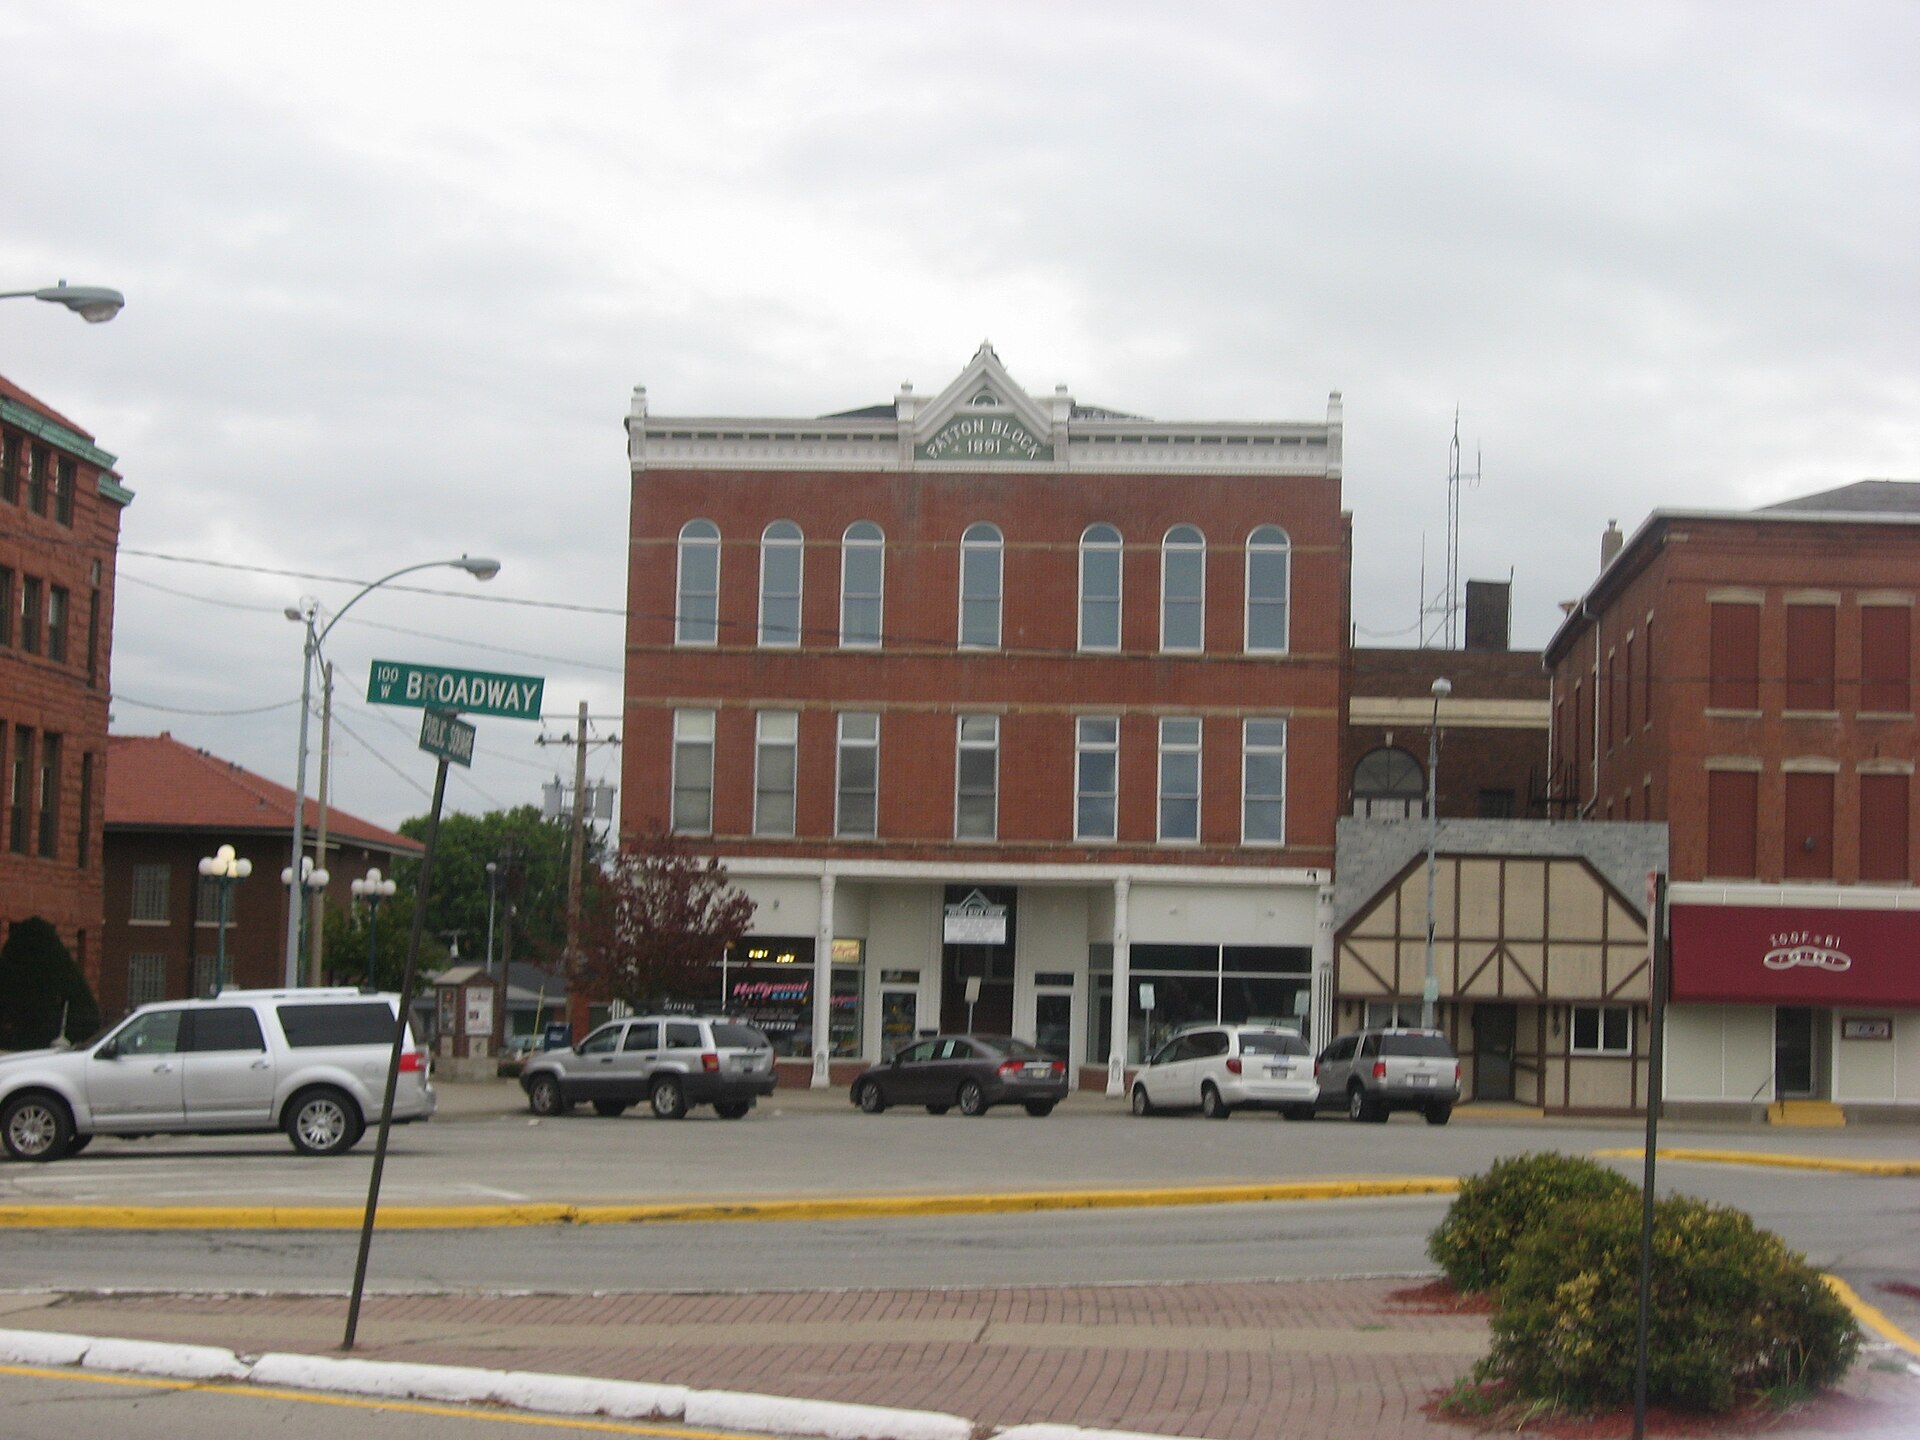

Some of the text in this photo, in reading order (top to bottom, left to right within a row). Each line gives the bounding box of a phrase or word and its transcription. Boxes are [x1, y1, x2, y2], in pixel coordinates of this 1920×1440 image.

[926, 418, 1041, 460] PATTON BLOCK
[377, 666, 538, 712] 100 BROADWAY
[380, 684, 392, 699] W
